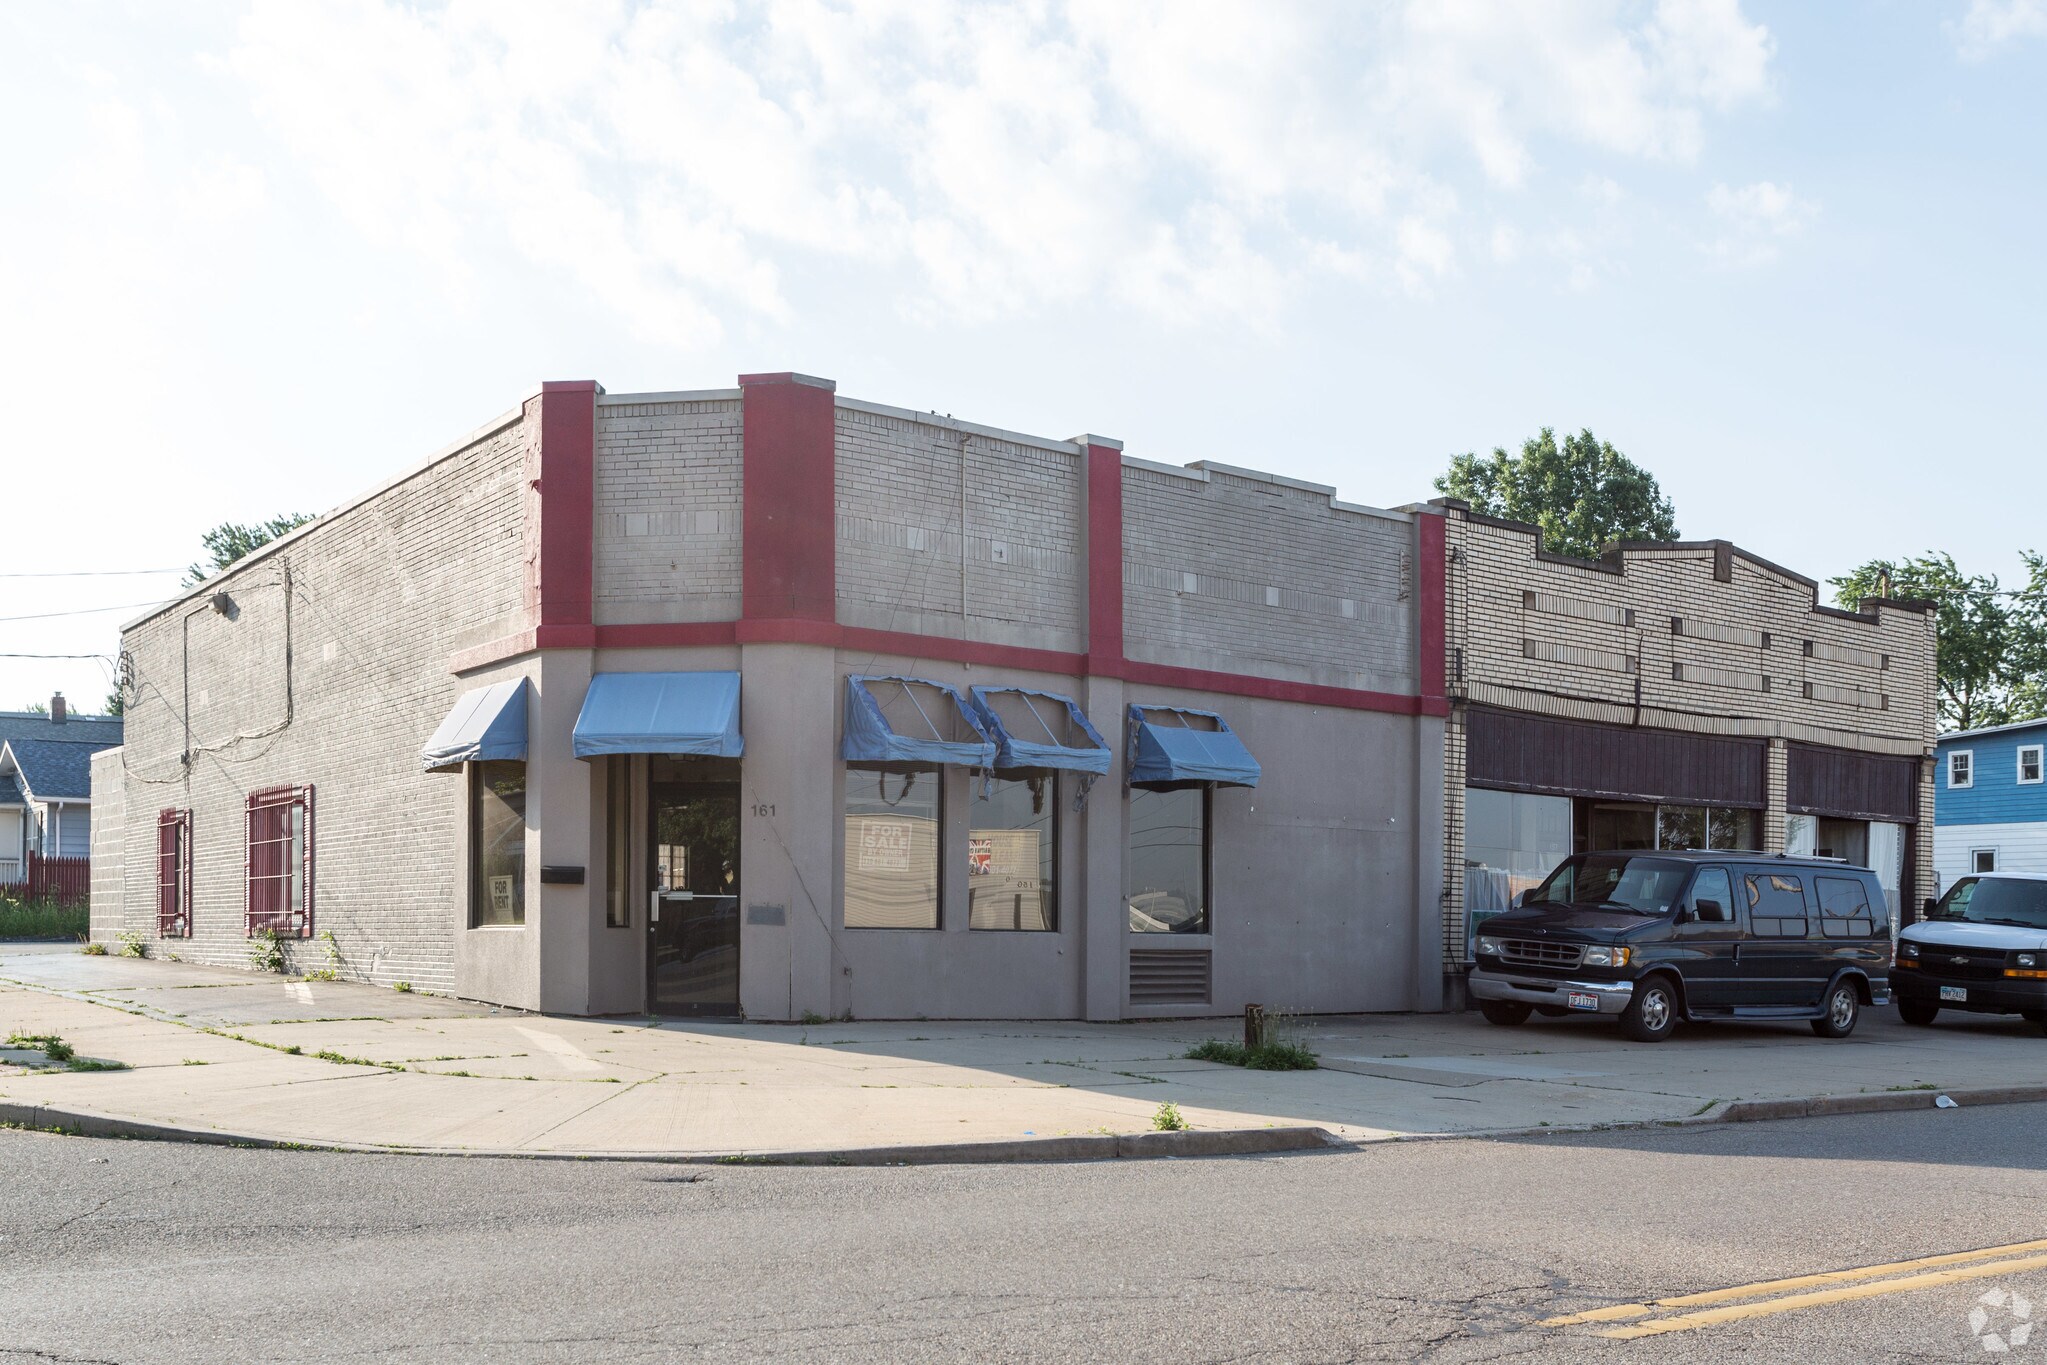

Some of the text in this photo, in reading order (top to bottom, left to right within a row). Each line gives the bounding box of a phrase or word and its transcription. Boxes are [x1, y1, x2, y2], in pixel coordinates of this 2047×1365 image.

[750, 804, 776, 817] 161
[871, 825, 902, 837] FOR
[864, 836, 908, 849] SALE
[494, 880, 507, 894] FOR
[494, 895, 509, 909] RENT
